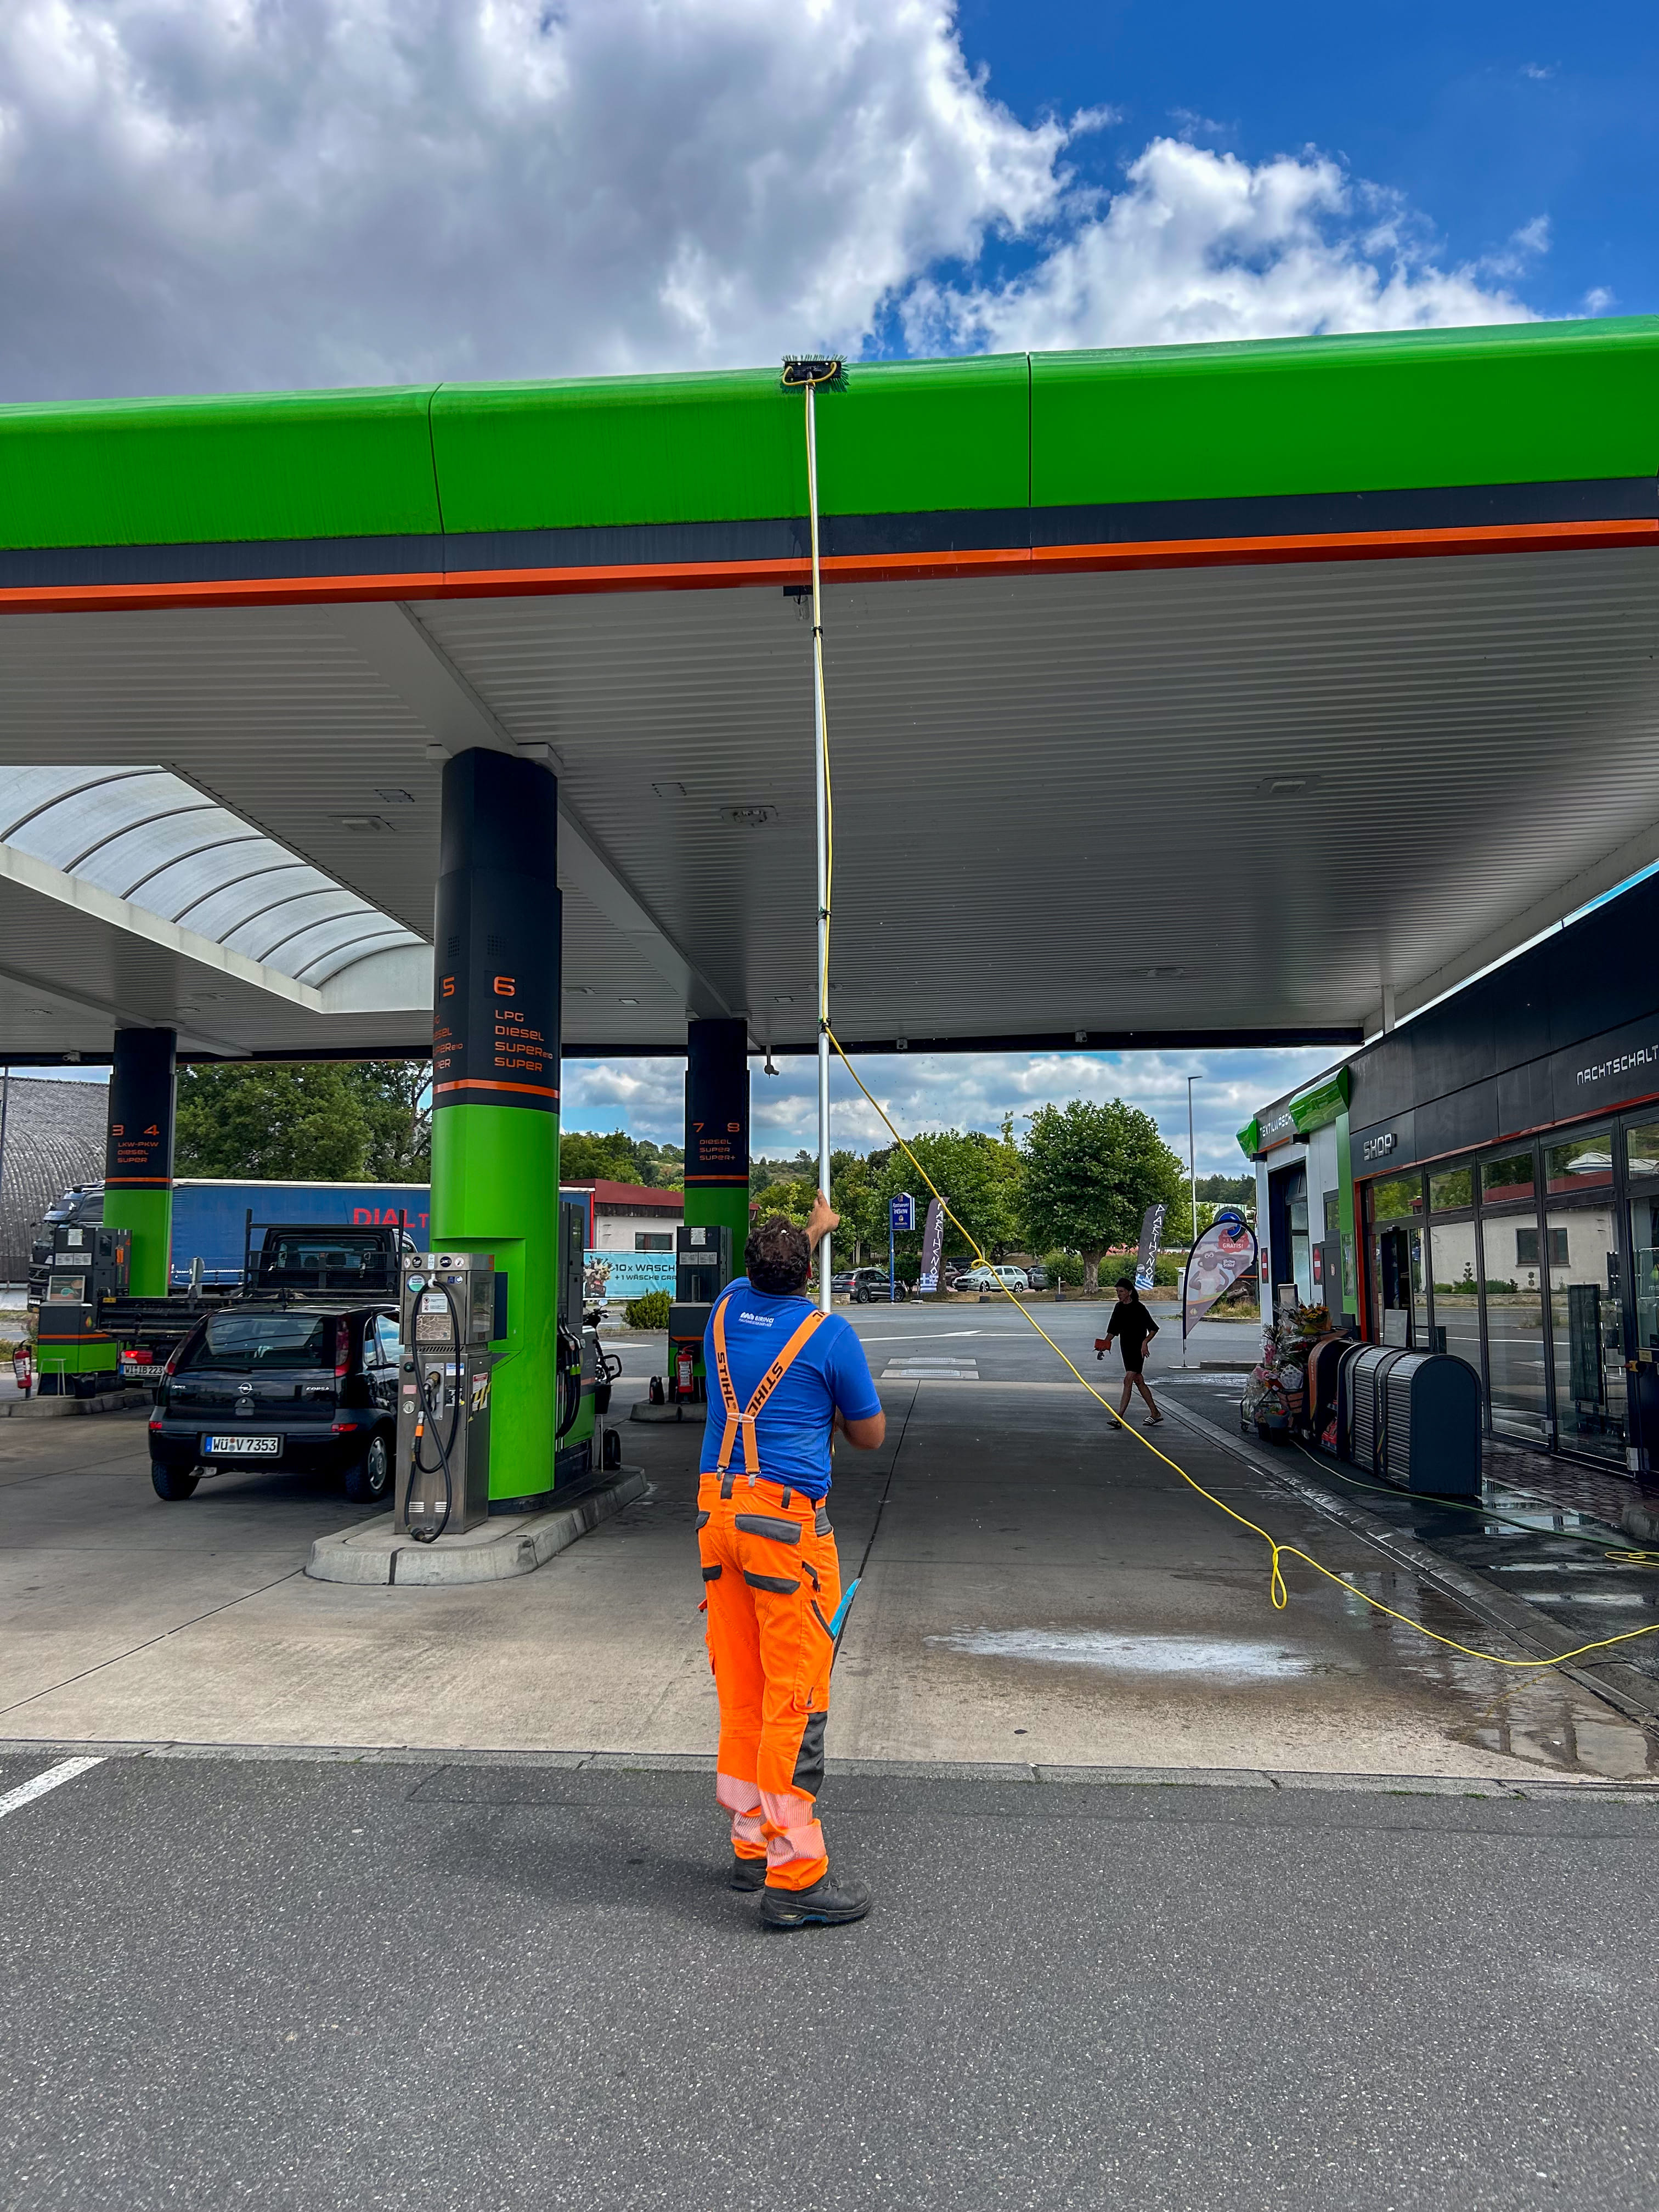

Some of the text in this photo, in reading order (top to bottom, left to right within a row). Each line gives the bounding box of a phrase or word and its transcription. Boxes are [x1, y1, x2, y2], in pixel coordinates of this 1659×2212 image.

[443, 976, 455, 997] 5
[494, 976, 516, 996] 6
[495, 1009, 524, 1022] LPG
[112, 1125, 124, 1136] 3
[144, 1125, 160, 1136] 4
[693, 1123, 704, 1132] 7
[727, 1123, 740, 1132] 8
[1363, 1133, 1392, 1161] SHOP
[717, 1352, 734, 1408] STIHL
[747, 1362, 783, 1413] STIHL
[213, 1438, 276, 1451] WÜ V 7353
